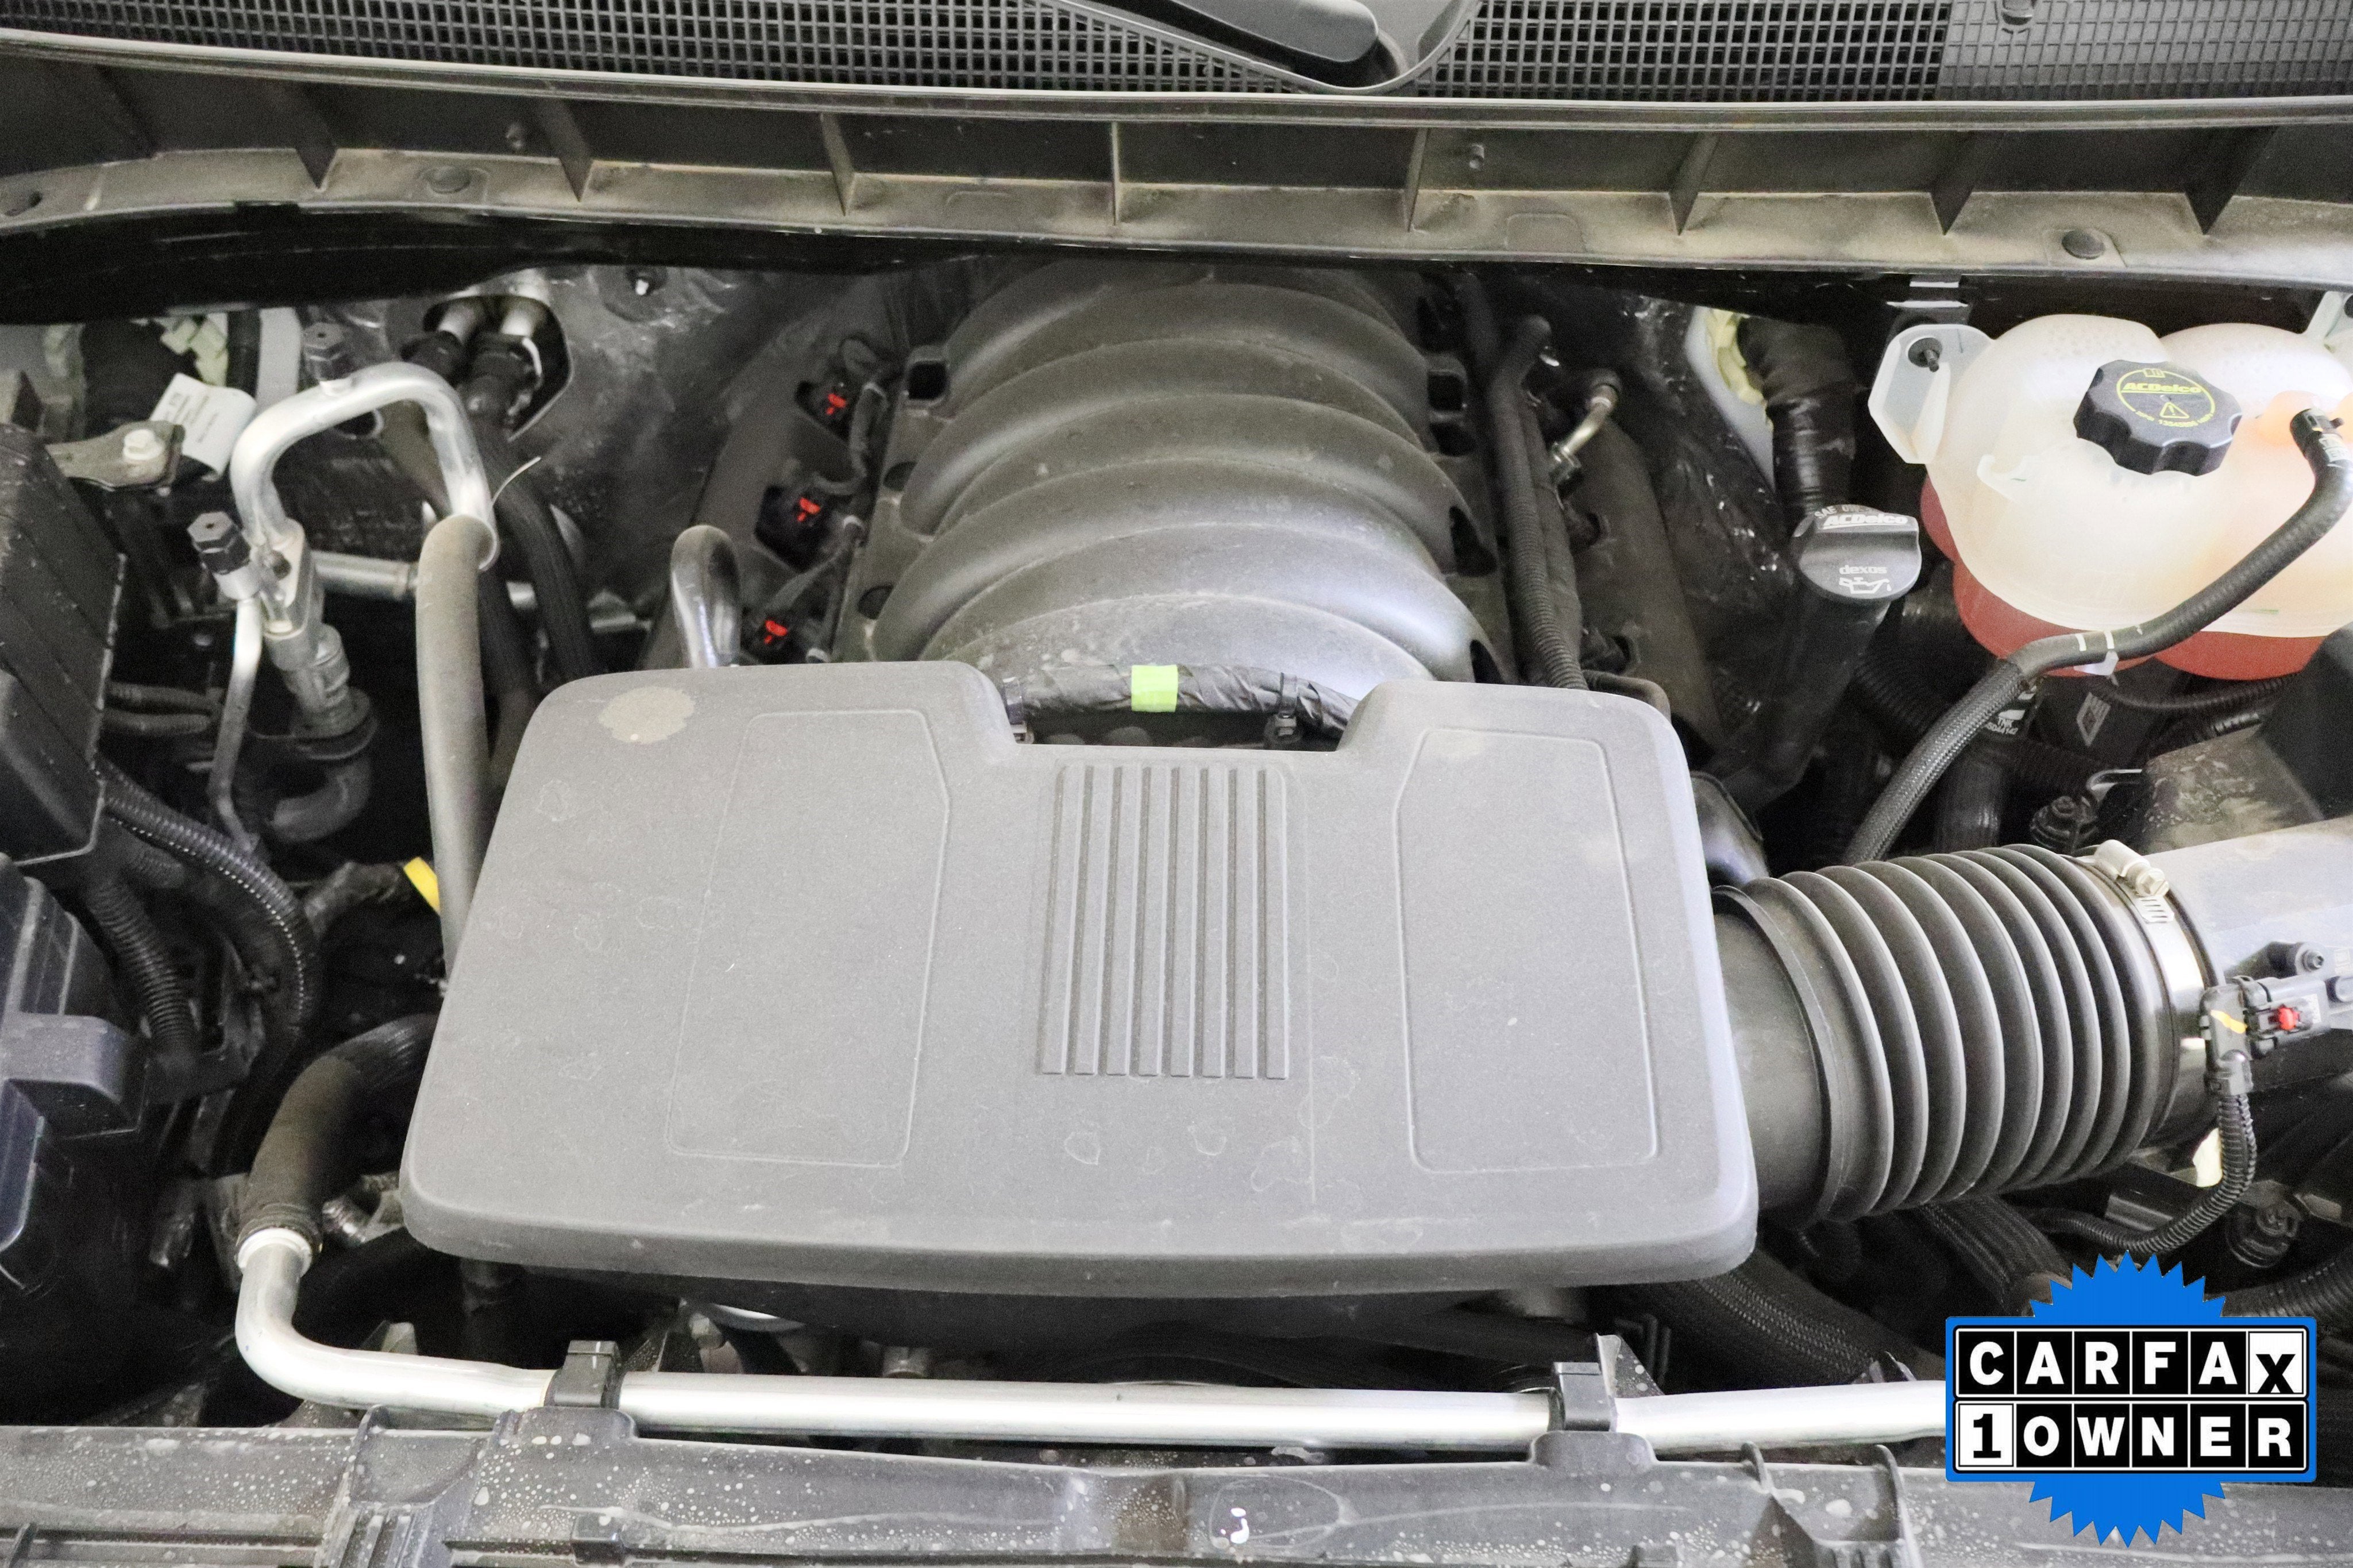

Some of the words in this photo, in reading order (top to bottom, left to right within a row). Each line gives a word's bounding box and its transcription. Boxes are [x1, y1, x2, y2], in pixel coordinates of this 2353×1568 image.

[2122, 381, 2204, 393] ACDelco
[1814, 505, 1837, 519] SAE
[1823, 513, 1908, 528] ACDelco
[1839, 565, 1888, 574] dexos
